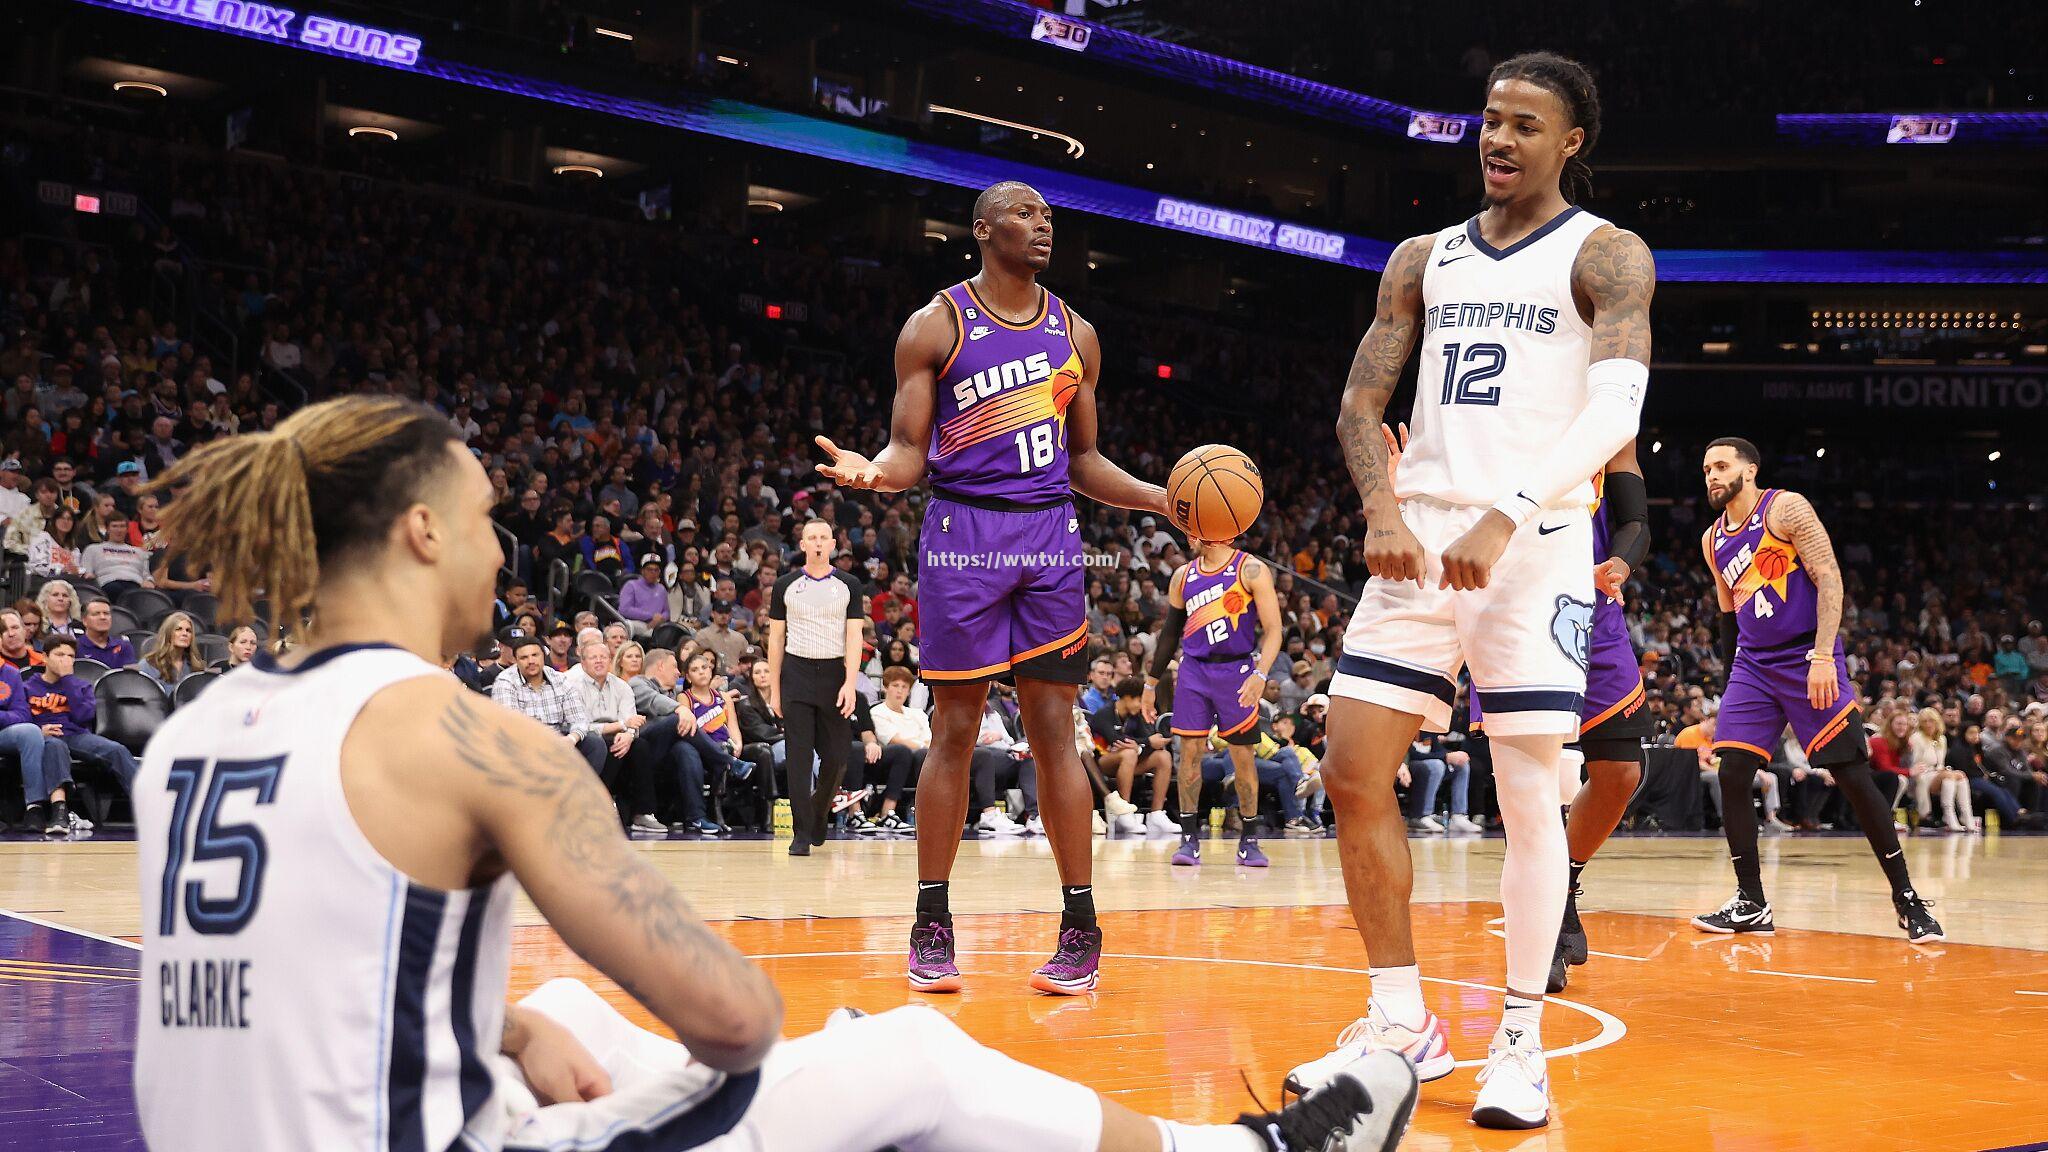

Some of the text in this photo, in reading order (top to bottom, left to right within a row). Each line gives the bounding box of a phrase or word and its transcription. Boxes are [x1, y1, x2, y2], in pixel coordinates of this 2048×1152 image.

[112, 0, 421, 65] OENIX SUNS
[1155, 198, 1346, 259] PHOENIX SUNS
[965, 307, 978, 320] 6
[1044, 327, 1066, 338] PayPal
[1428, 302, 1559, 335] MEMPHIS
[953, 351, 1052, 412] SUNS
[1440, 342, 1507, 407] 12
[1863, 375, 2048, 408] HORNITO
[1014, 423, 1056, 474] 18
[1754, 589, 1774, 619] 4
[1205, 618, 1230, 646] 12
[1813, 717, 1850, 753] PHOENIX
[159, 752, 291, 936] 15
[160, 959, 252, 1029] CLARKE
